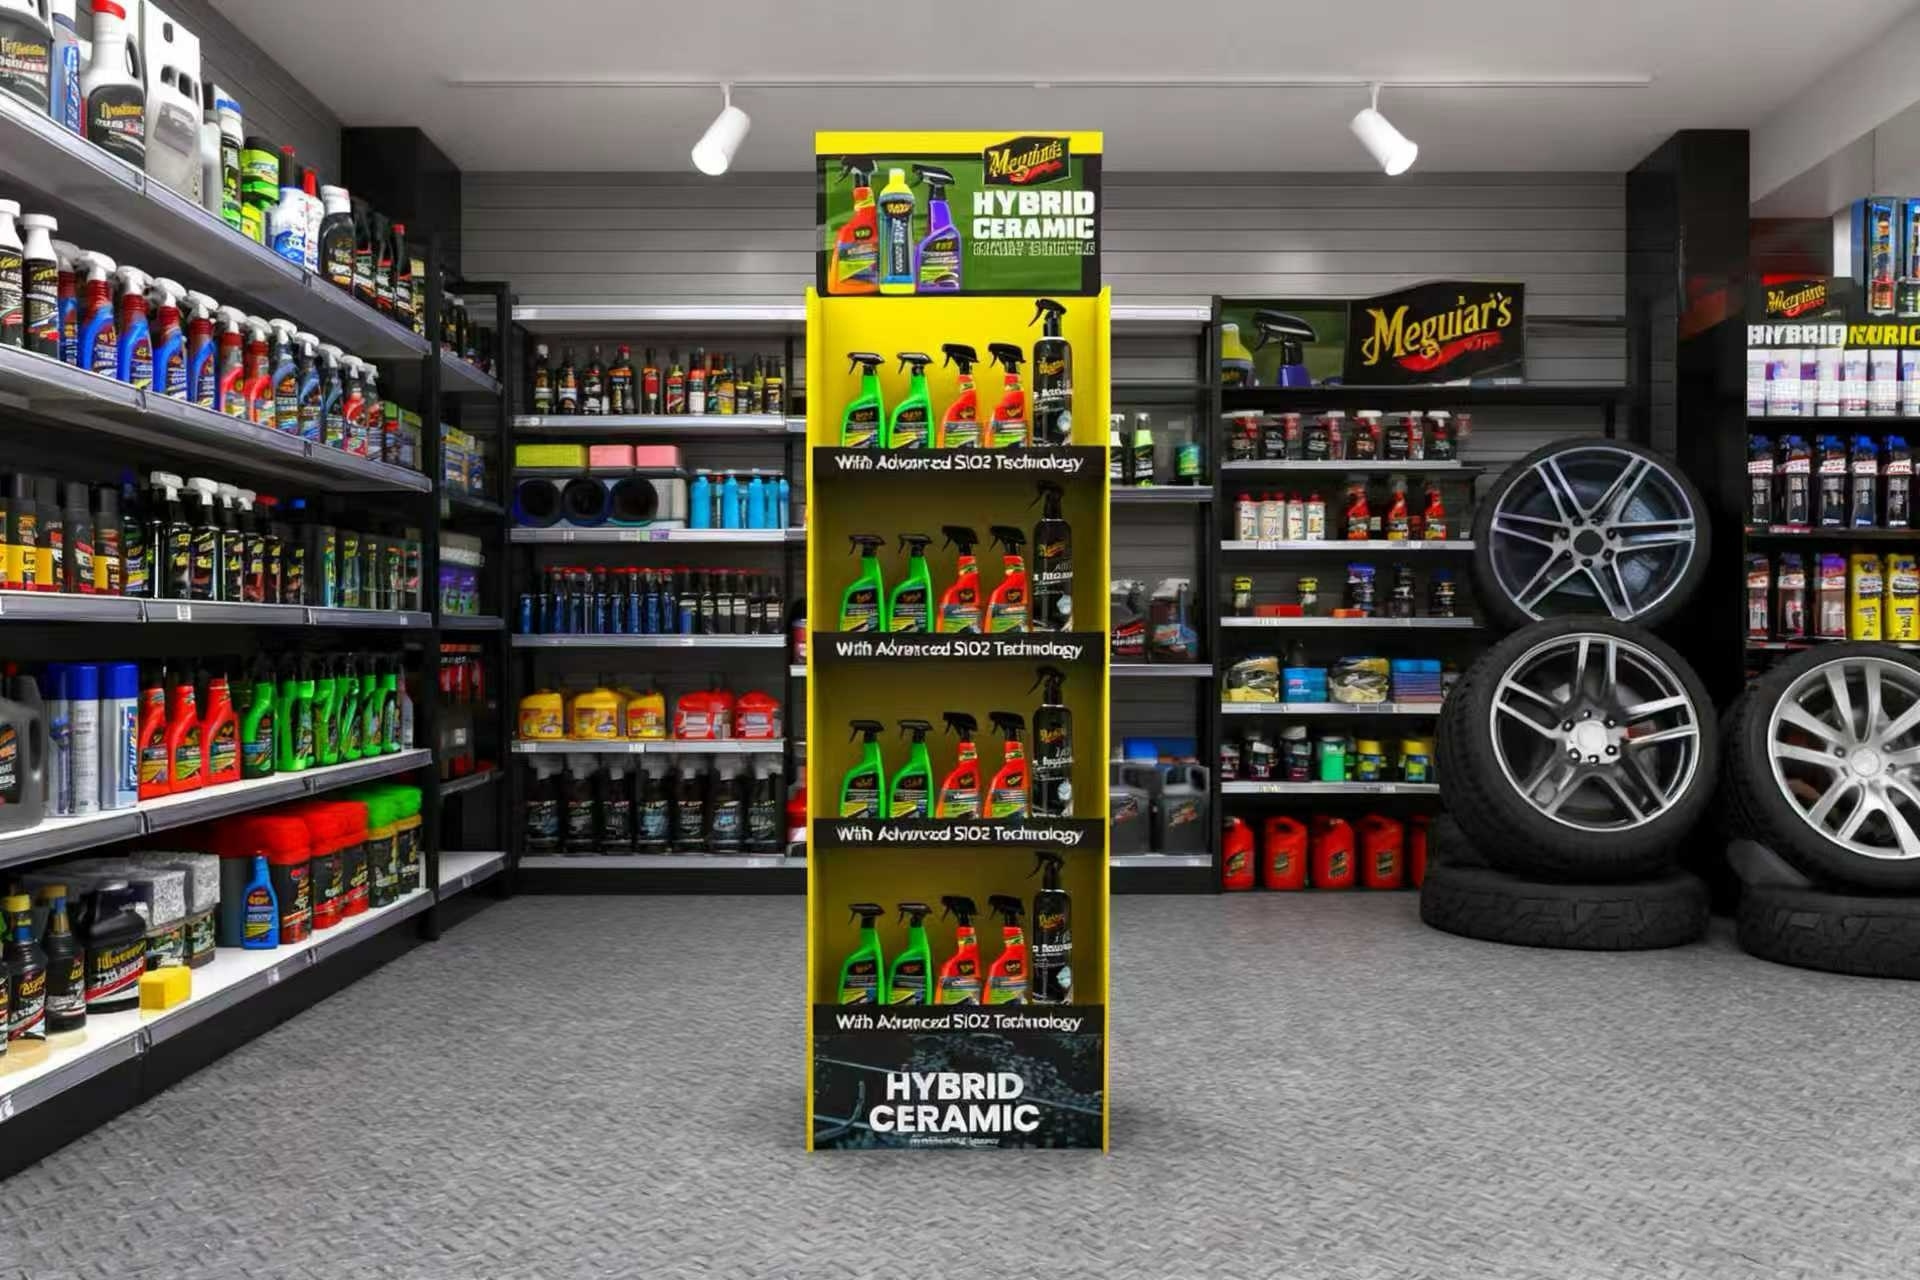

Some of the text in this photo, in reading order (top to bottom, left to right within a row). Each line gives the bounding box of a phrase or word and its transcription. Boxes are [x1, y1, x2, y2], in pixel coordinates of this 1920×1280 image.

[973, 190, 1095, 216] HYBRID
[973, 217, 1095, 239] CERAMIC
[1362, 292, 1512, 366] Meguiar's
[835, 639, 873, 656] With
[835, 825, 873, 841] With
[835, 1014, 873, 1030] With
[886, 1071, 1024, 1101] HYBRID
[869, 1104, 1040, 1133] CERAMIC
